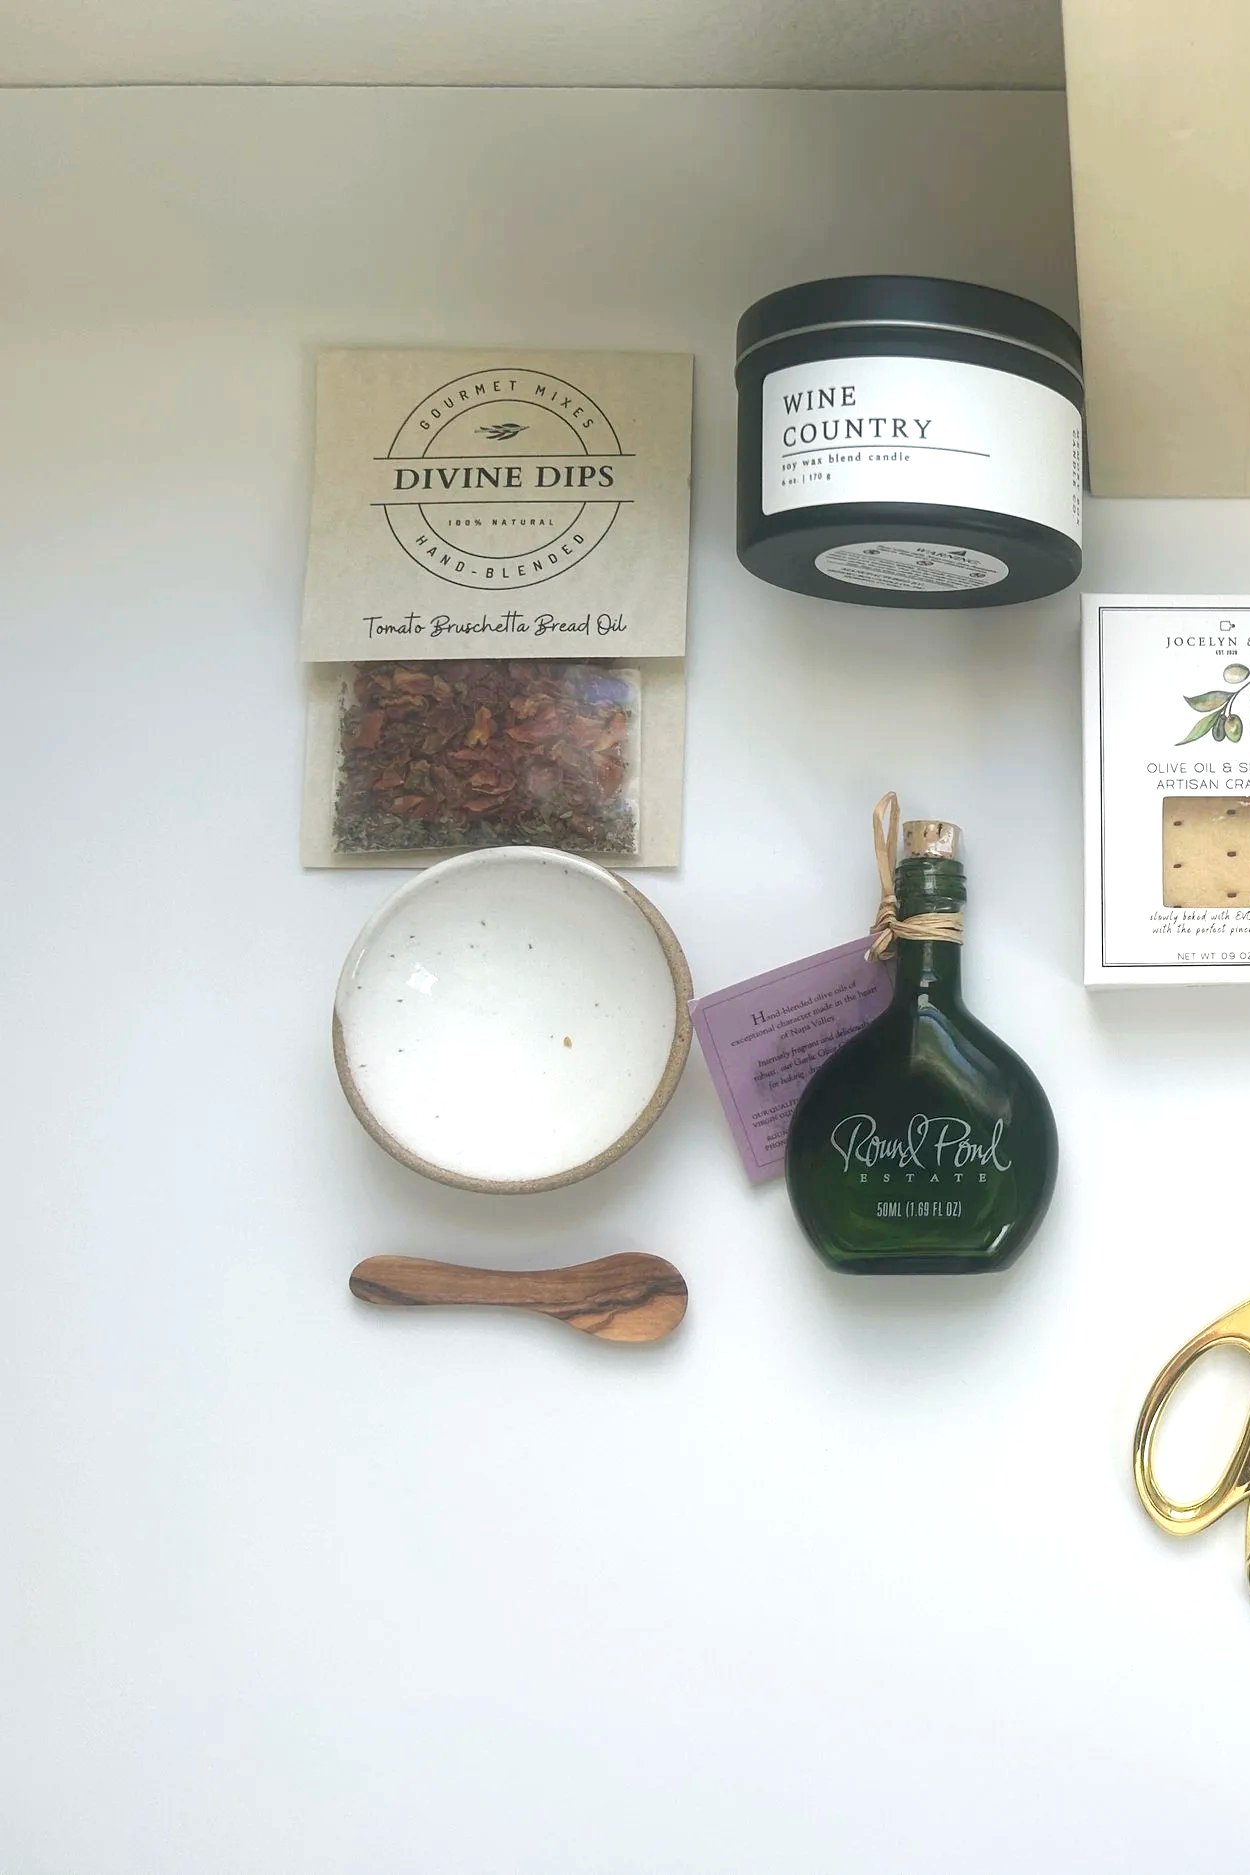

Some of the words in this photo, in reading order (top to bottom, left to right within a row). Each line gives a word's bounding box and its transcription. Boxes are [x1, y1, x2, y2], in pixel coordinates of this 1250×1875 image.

[420, 380, 517, 430] GOURMET
[535, 385, 594, 429] MIXES
[783, 386, 856, 415] WINE
[783, 417, 932, 447] COUNTRY
[781, 462, 797, 471] soy
[802, 457, 823, 466] wax
[828, 452, 861, 464] blend
[868, 452, 910, 461] candle
[393, 466, 523, 491] DIVINE
[536, 465, 615, 488] DIPS
[809, 472, 823, 482] 170
[448, 518, 482, 527] 100%
[492, 518, 555, 527] NATURAL
[415, 533, 585, 579] HAND-BLENDED
[363, 612, 425, 638] Tomato
[430, 611, 530, 637] Bruschetta
[534, 614, 591, 635] Bread
[597, 614, 627, 635] Oil
[1166, 637, 1237, 648] JOCELYN
[1147, 762, 1187, 773] OLIVE
[1194, 762, 1215, 773] OIL
[1222, 762, 1232, 773] &
[1156, 779, 1219, 789] ARTISAN
[1150, 911, 1178, 924] slowly
[1182, 910, 1206, 921] baked
[1210, 910, 1230, 920] with
[1152, 923, 1171, 934] with
[1177, 923, 1191, 934] the
[1196, 923, 1226, 936] perfect
[1177, 952, 1196, 960] NET
[1201, 952, 1216, 960] WT
[752, 995, 813, 1025] Hand-blended
[813, 990, 833, 1002] olive
[729, 1025, 775, 1047] exceptional
[776, 1011, 812, 1029] character
[812, 1002, 834, 1015] made
[843, 993, 856, 1003] the
[790, 1024, 812, 1037] Napa
[752, 1110, 769, 1120] OUR
[830, 1113, 929, 1172] Round
[917, 1117, 1012, 1171] Pond
[860, 1173, 987, 1183] ESTATE
[876, 1202, 901, 1217] 50ML
[906, 1201, 929, 1217] (1.69
[933, 1202, 943, 1217] FL
[946, 1201, 962, 1217] OZ)
